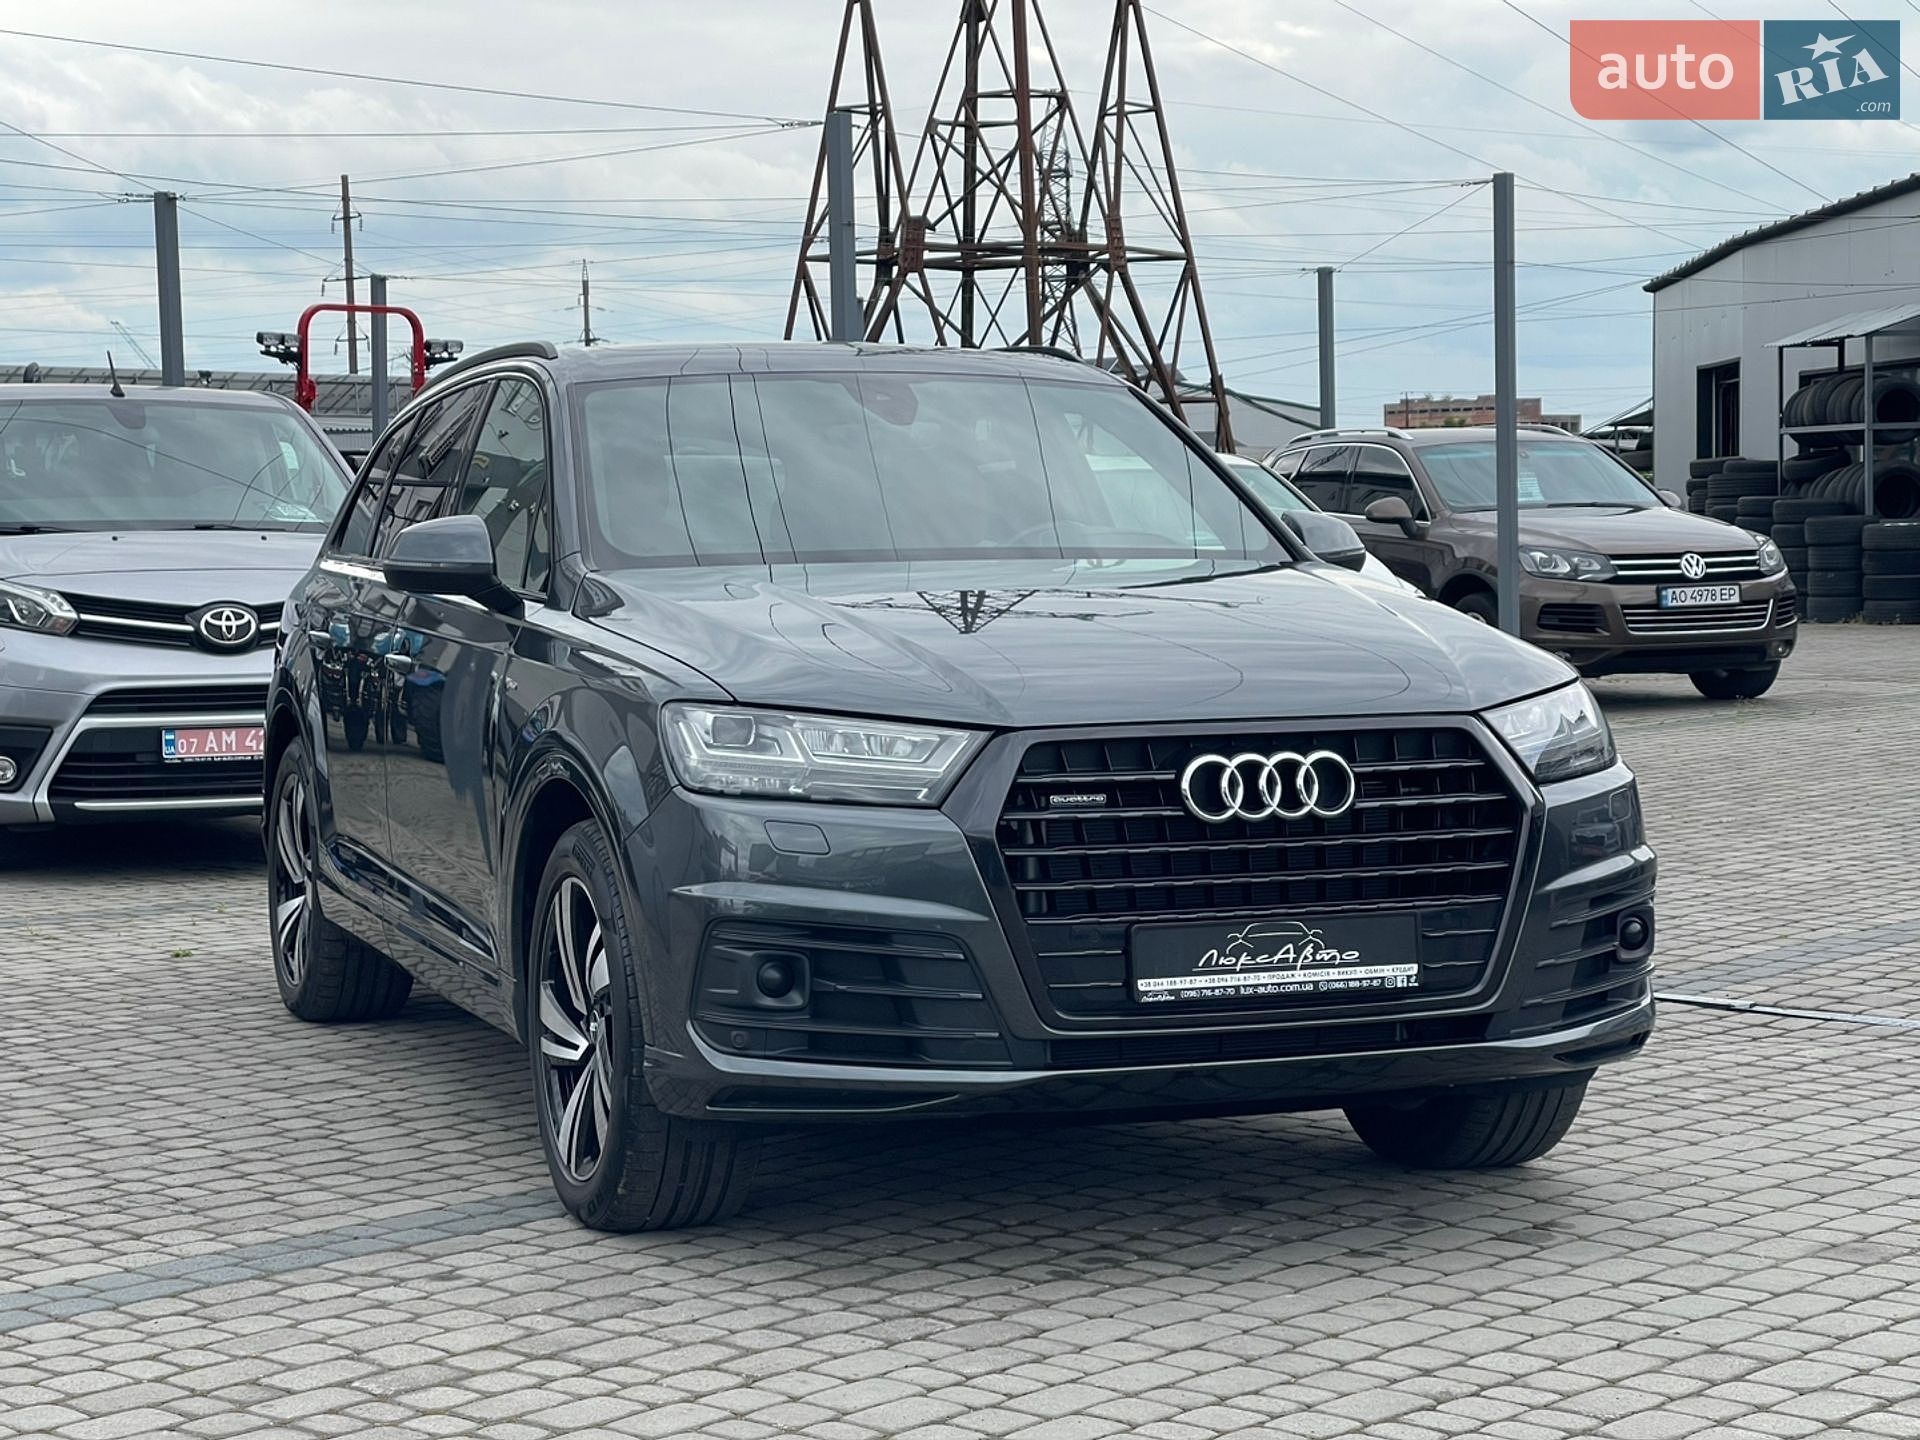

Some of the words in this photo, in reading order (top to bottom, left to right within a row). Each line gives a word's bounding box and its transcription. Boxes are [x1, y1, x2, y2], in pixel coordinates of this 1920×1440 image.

[1670, 590, 1687, 603] AO
[1690, 588, 1718, 602] 4978
[1720, 587, 1736, 601] EP
[178, 738, 198, 753] 07
[205, 730, 236, 752] AM
